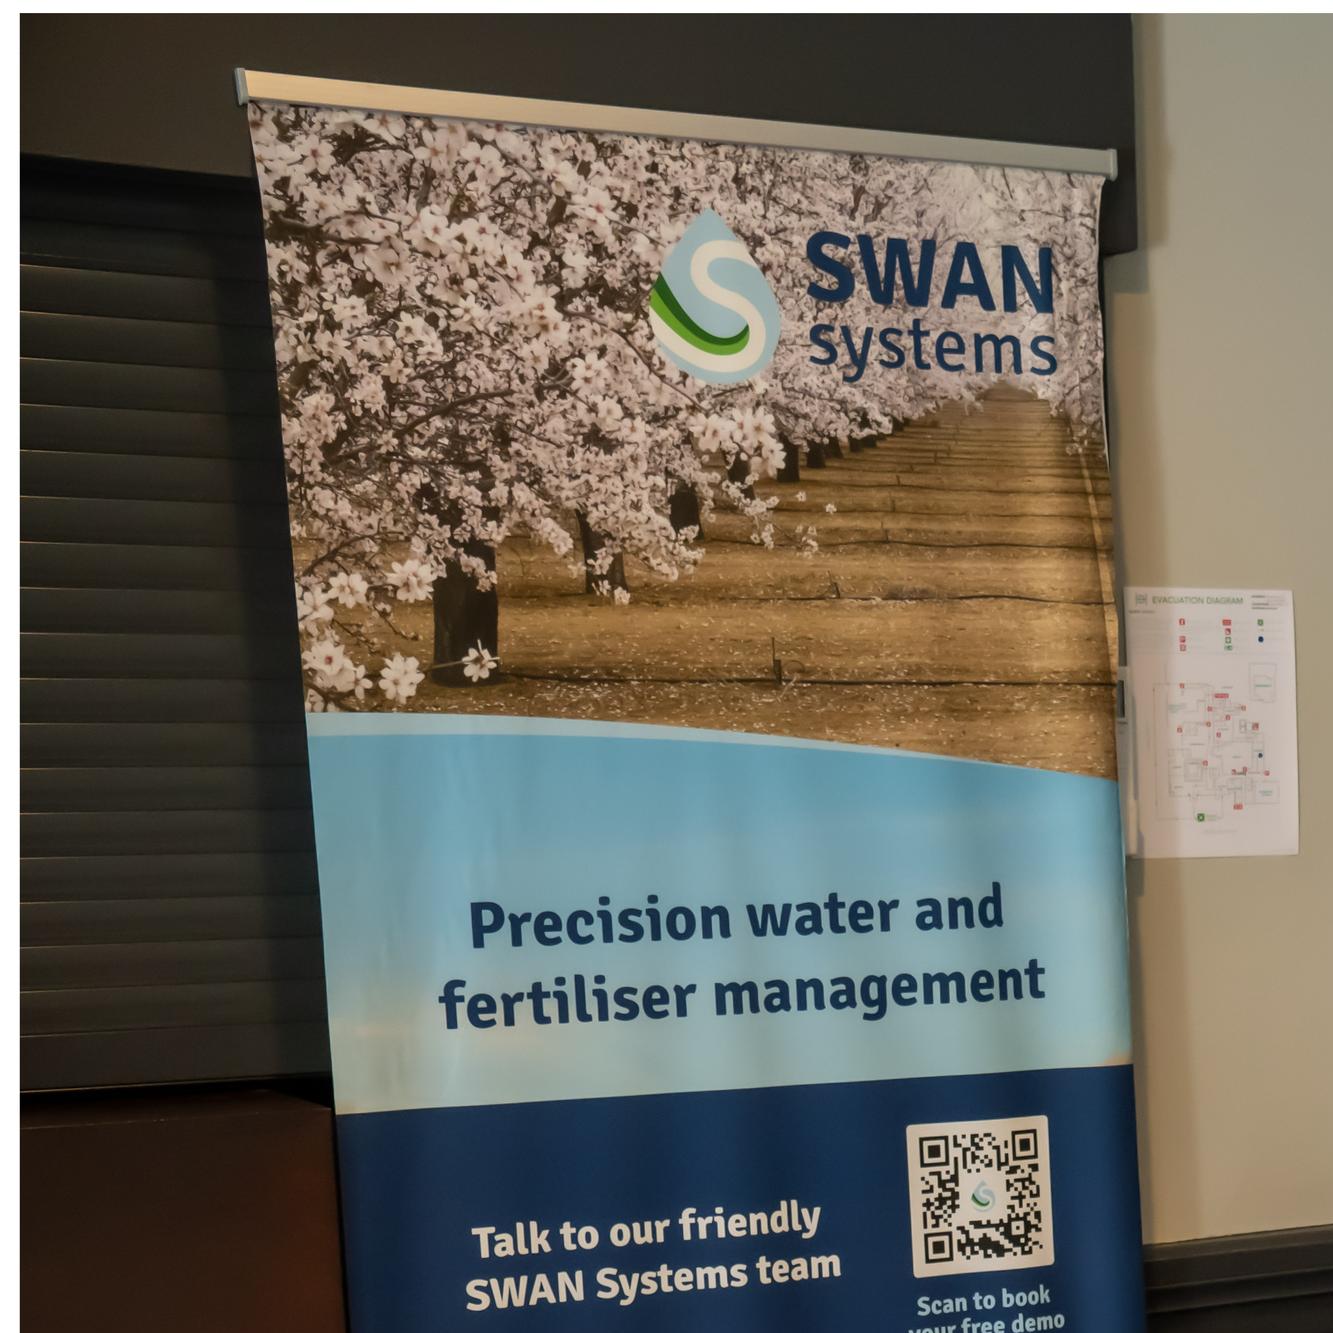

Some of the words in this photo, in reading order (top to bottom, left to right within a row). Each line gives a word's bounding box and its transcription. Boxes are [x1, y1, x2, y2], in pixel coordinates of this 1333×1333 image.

[806, 231, 1054, 314] SWAN
[809, 318, 1058, 383] systems
[469, 894, 732, 949] Precision
[745, 890, 900, 938] water
[915, 881, 1004, 932] and
[438, 973, 697, 1030] fertiliser
[714, 958, 1046, 1022] management
[471, 1221, 552, 1259] Talk
[559, 1221, 600, 1251] to
[609, 1218, 671, 1247] our
[678, 1199, 822, 1241] friendly
[465, 1269, 585, 1312] SWAN
[596, 1263, 749, 1306] Systems
[755, 1254, 842, 1285] team
[916, 1296, 968, 1317] Scan
[972, 1291, 996, 1311] to
[1001, 1283, 1051, 1308] book
[1011, 1312, 1066, 1333] demo
